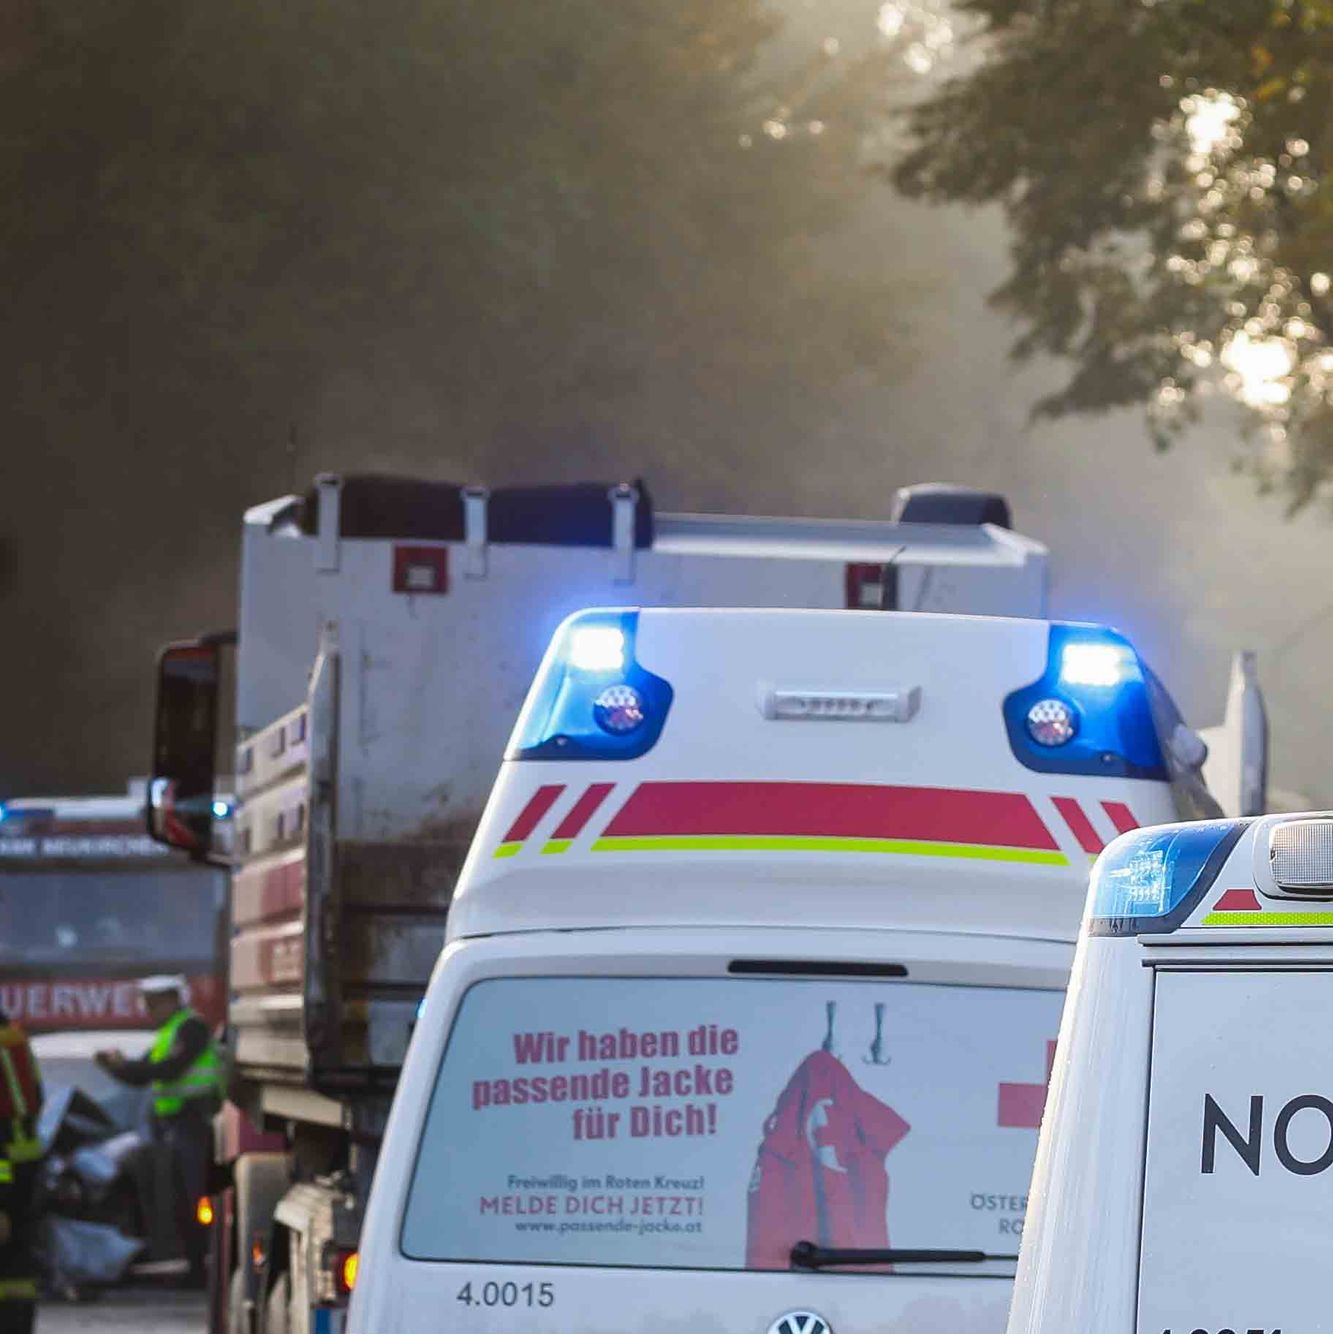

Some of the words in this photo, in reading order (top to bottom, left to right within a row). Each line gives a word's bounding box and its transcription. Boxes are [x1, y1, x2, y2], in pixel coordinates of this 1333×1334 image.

[0, 981, 150, 1018] UERWE
[513, 1032, 570, 1064] Wir
[578, 1027, 679, 1061] haben
[687, 1024, 739, 1056] die
[472, 1067, 630, 1111] passende
[638, 1064, 734, 1098] Jacke
[572, 1106, 620, 1140] für
[630, 1103, 717, 1138] Dich!
[507, 1175, 578, 1191] Freiwillig
[583, 1177, 601, 1189] im
[606, 1176, 650, 1190] Roten
[655, 1175, 704, 1190] Kreuz!
[480, 1196, 557, 1215] MELDE
[565, 1196, 624, 1215] DICH
[630, 1196, 703, 1215] JETZT!
[515, 1220, 703, 1235] www.passende-jacke.at
[457, 1281, 554, 1307] 4.0015
